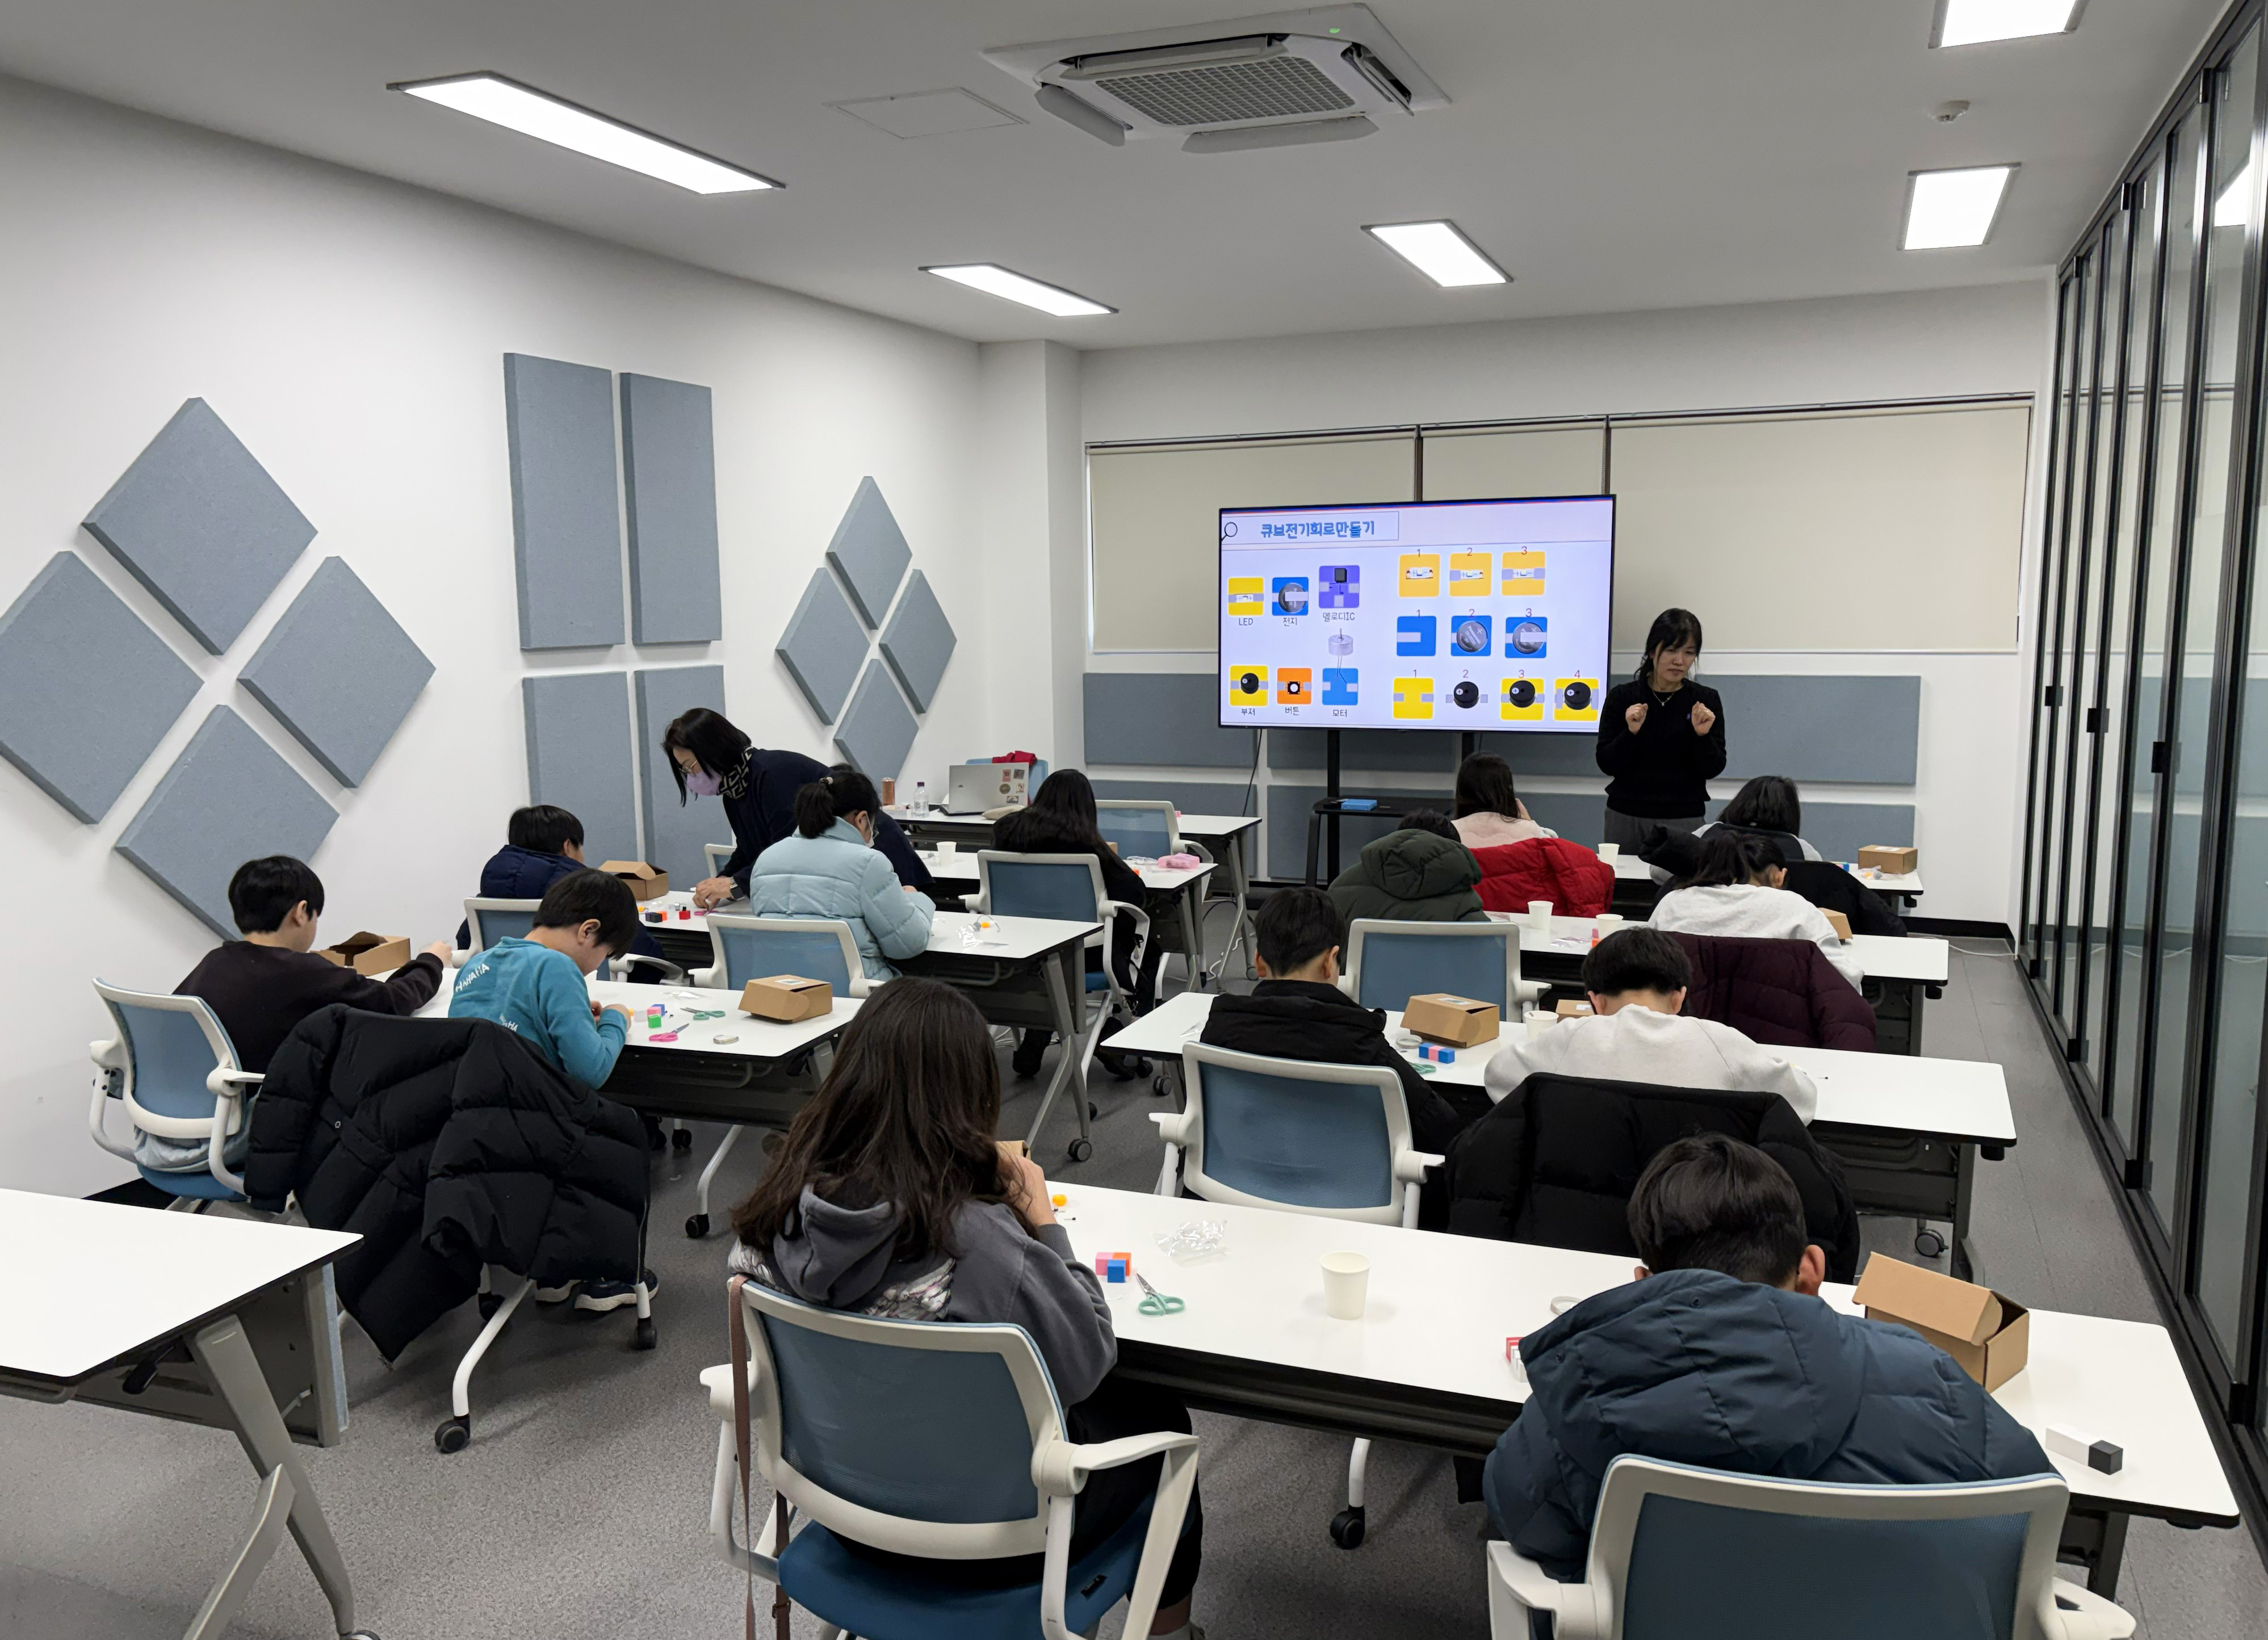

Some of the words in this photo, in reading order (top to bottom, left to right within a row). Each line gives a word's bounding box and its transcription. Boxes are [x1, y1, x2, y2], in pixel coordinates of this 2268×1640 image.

[1261, 521, 1374, 539] 큐브전기회로만들기
[1417, 549, 1420, 557] 1
[1521, 546, 1527, 555] 3
[1323, 612, 1355, 622] 멜로디IC
[1469, 609, 1475, 617] 2
[1525, 608, 1532, 617] 3
[1239, 618, 1254, 626] LED
[1283, 617, 1297, 627] 전지
[1574, 670, 1581, 678] 4
[1285, 706, 1299, 716] 버튼
